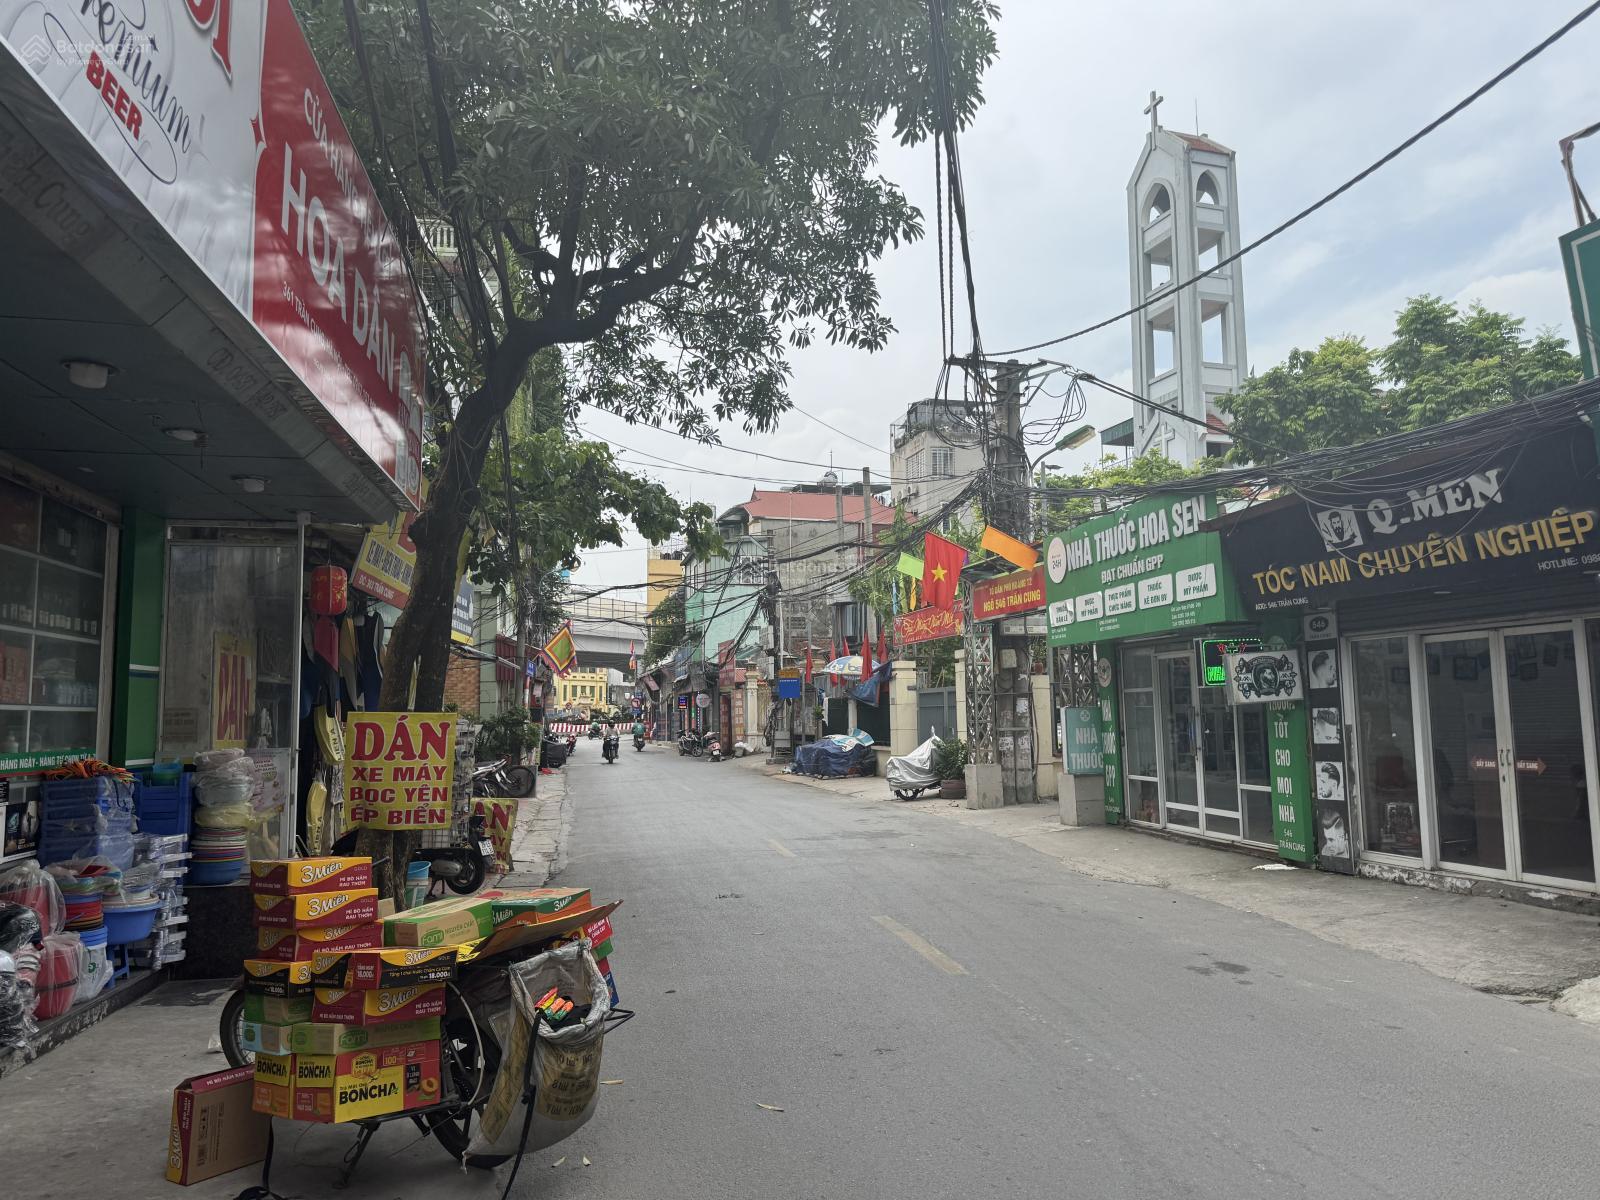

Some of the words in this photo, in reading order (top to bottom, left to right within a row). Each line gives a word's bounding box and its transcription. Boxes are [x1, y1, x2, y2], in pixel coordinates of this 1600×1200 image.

[85, 50, 144, 142] BEER
[280, 141, 347, 324] HOA
[281, 282, 294, 305] 361
[294, 295, 310, 328] TRẦN
[1065, 531, 1093, 572] NHÀ
[1093, 513, 1137, 562] THUỐC
[1138, 508, 1170, 549] HOA
[1171, 494, 1207, 538] SEN
[1252, 564, 1297, 595] TÓC
[1300, 558, 1351, 588] NAM
[1357, 532, 1469, 578] CHUYÊN
[1475, 506, 1596, 561] NGHIỆP
[1101, 566, 1117, 585] ĐẠT
[1117, 555, 1146, 578] CHUẨN
[1146, 553, 1164, 572] GPP
[1537, 556, 1580, 571] HOTLINE:
[1006, 590, 1023, 607] TRẦN
[1023, 588, 1041, 603] CUNG
[351, 714, 451, 761] DÁN
[1075, 723, 1098, 745] NHÀ
[19, 755, 36, 769] NGÀY
[1070, 747, 1104, 770] THUỐC
[1275, 748, 1291, 767] CHO
[352, 766, 383, 782] XE
[392, 763, 447, 782] MÁY
[1105, 764, 1116, 787] GPP
[350, 786, 396, 807] BỌC
[404, 784, 448, 803] YÊN
[1277, 776, 1293, 798] MỌI
[350, 804, 379, 823] ÉP
[387, 803, 446, 825] BIỂN
[1278, 801, 1296, 824] NHÀ
[1292, 842, 1306, 853] CUNG
[256, 1060, 288, 1077] BONCHA
[298, 1065, 331, 1079] BONCHA
[338, 1082, 399, 1105] BONCHA
